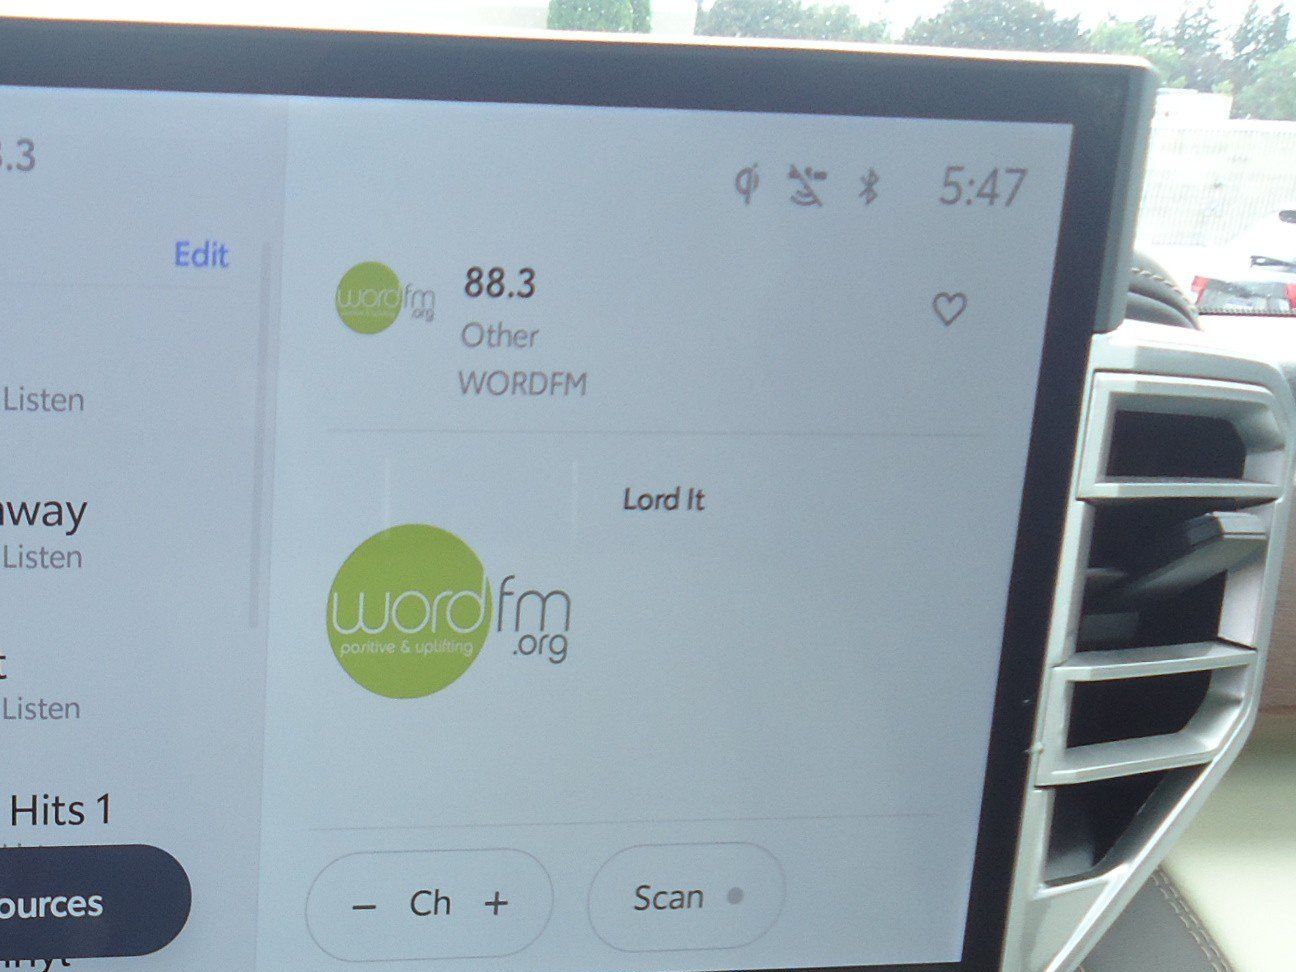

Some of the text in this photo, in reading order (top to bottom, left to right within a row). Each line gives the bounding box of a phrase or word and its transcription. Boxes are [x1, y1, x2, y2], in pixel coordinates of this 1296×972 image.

[939, 166, 1029, 208] 5:47
[174, 240, 230, 269] Edit
[464, 266, 537, 299] 88.3
[461, 322, 540, 350] Other
[457, 370, 587, 398] WORDFM
[4, 387, 85, 413] Listen
[622, 485, 704, 512] Lord It
[3, 544, 83, 569] Listen
[3, 697, 81, 721] Listen
[11, 794, 85, 827] Hits
[97, 793, 110, 824] 1
[410, 888, 451, 917] Ch
[633, 885, 704, 912] Scan
